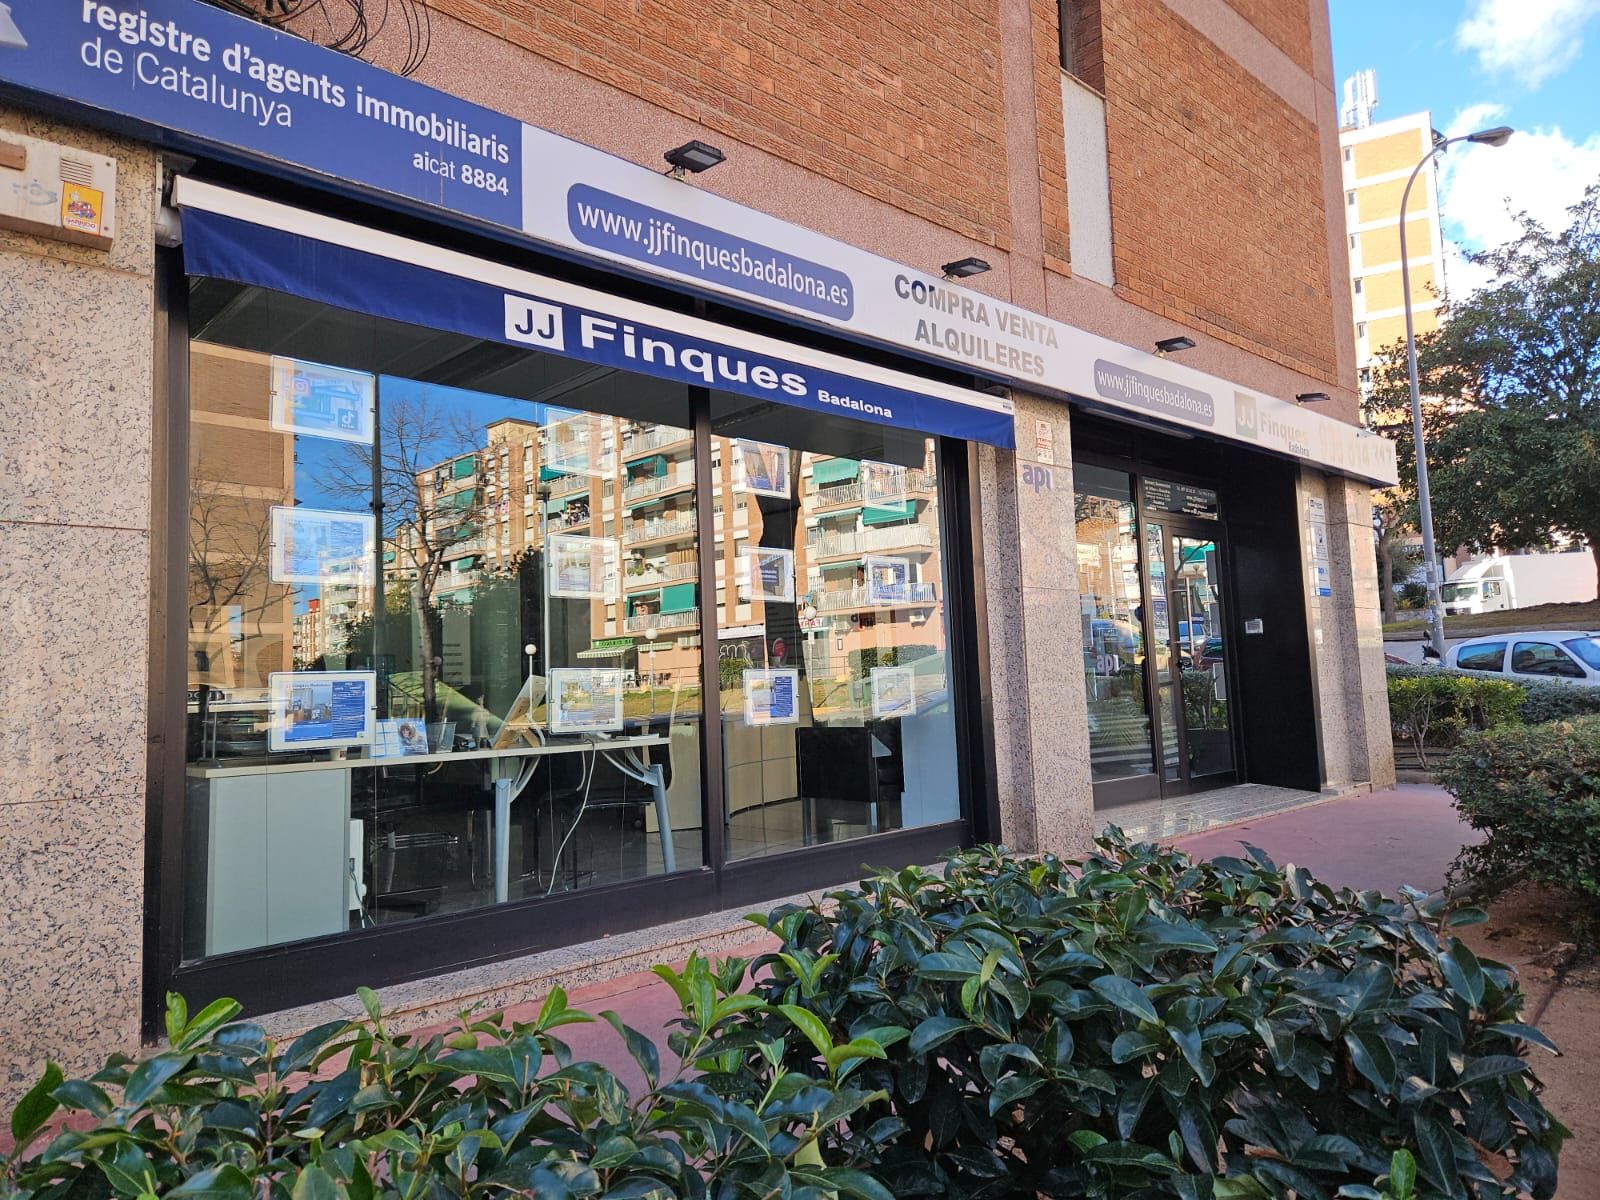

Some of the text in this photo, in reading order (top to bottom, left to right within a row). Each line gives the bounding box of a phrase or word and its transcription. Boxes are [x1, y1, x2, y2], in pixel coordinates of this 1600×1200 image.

[80, 37, 293, 128] de Catalunya
[82, 0, 211, 62] registre
[356, 85, 510, 164] immobiliaris
[413, 151, 509, 197] aicat 8884
[577, 202, 849, 307] www.jjfinquesbadalona.es
[894, 273, 1059, 350] COMPRA VENTA
[914, 318, 1045, 378] ALQUILERES
[514, 308, 893, 419] JJ Finques Badalona
[1097, 370, 1213, 418] www.jjfinquesbadalona.es
[1259, 411, 1308, 444] Finques
